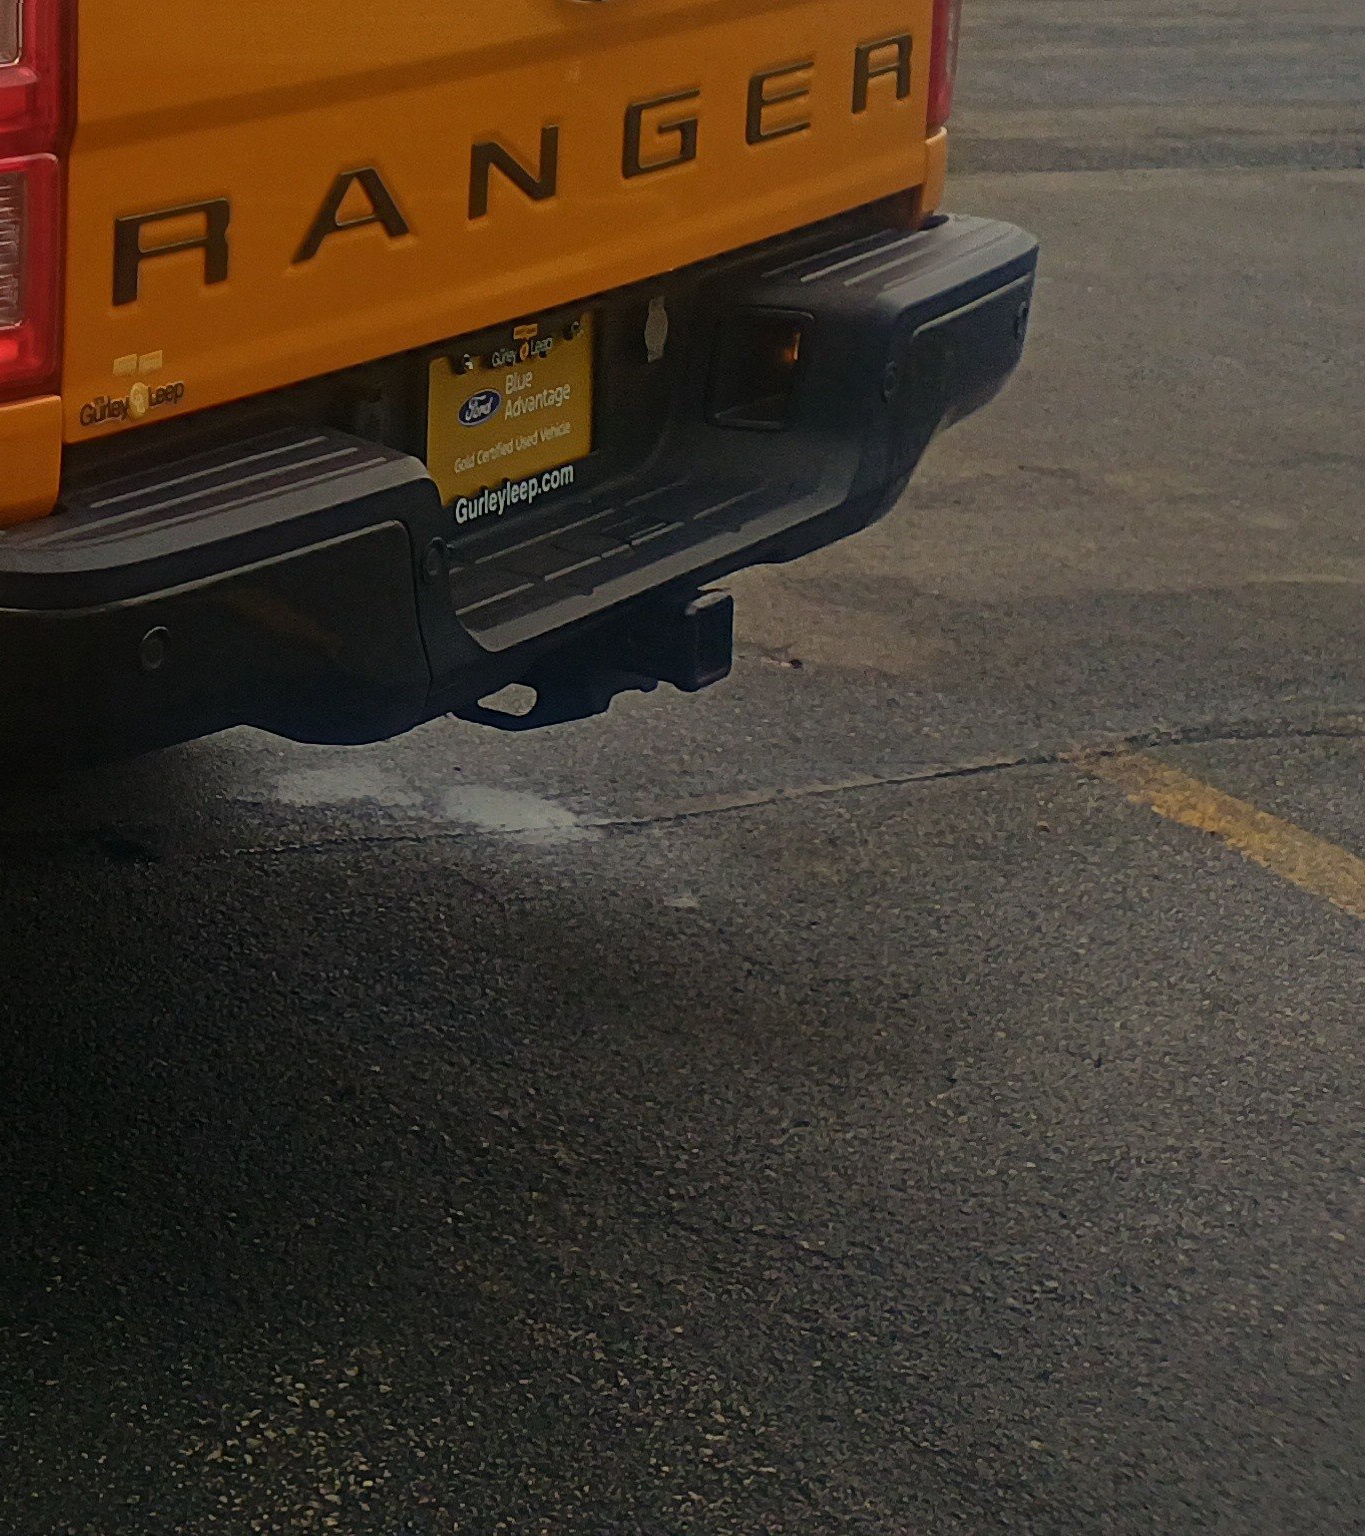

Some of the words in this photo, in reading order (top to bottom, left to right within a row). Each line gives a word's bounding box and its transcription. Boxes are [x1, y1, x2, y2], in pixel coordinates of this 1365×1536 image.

[111, 31, 914, 309] RANGER
[504, 382, 571, 420] Advantage
[505, 370, 534, 395] Blue
[453, 452, 476, 473] Gold
[476, 438, 514, 465] Certified
[515, 430, 538, 451] Used
[539, 421, 571, 442] Vehicle
[454, 464, 575, 525] Gurleyleep.com
